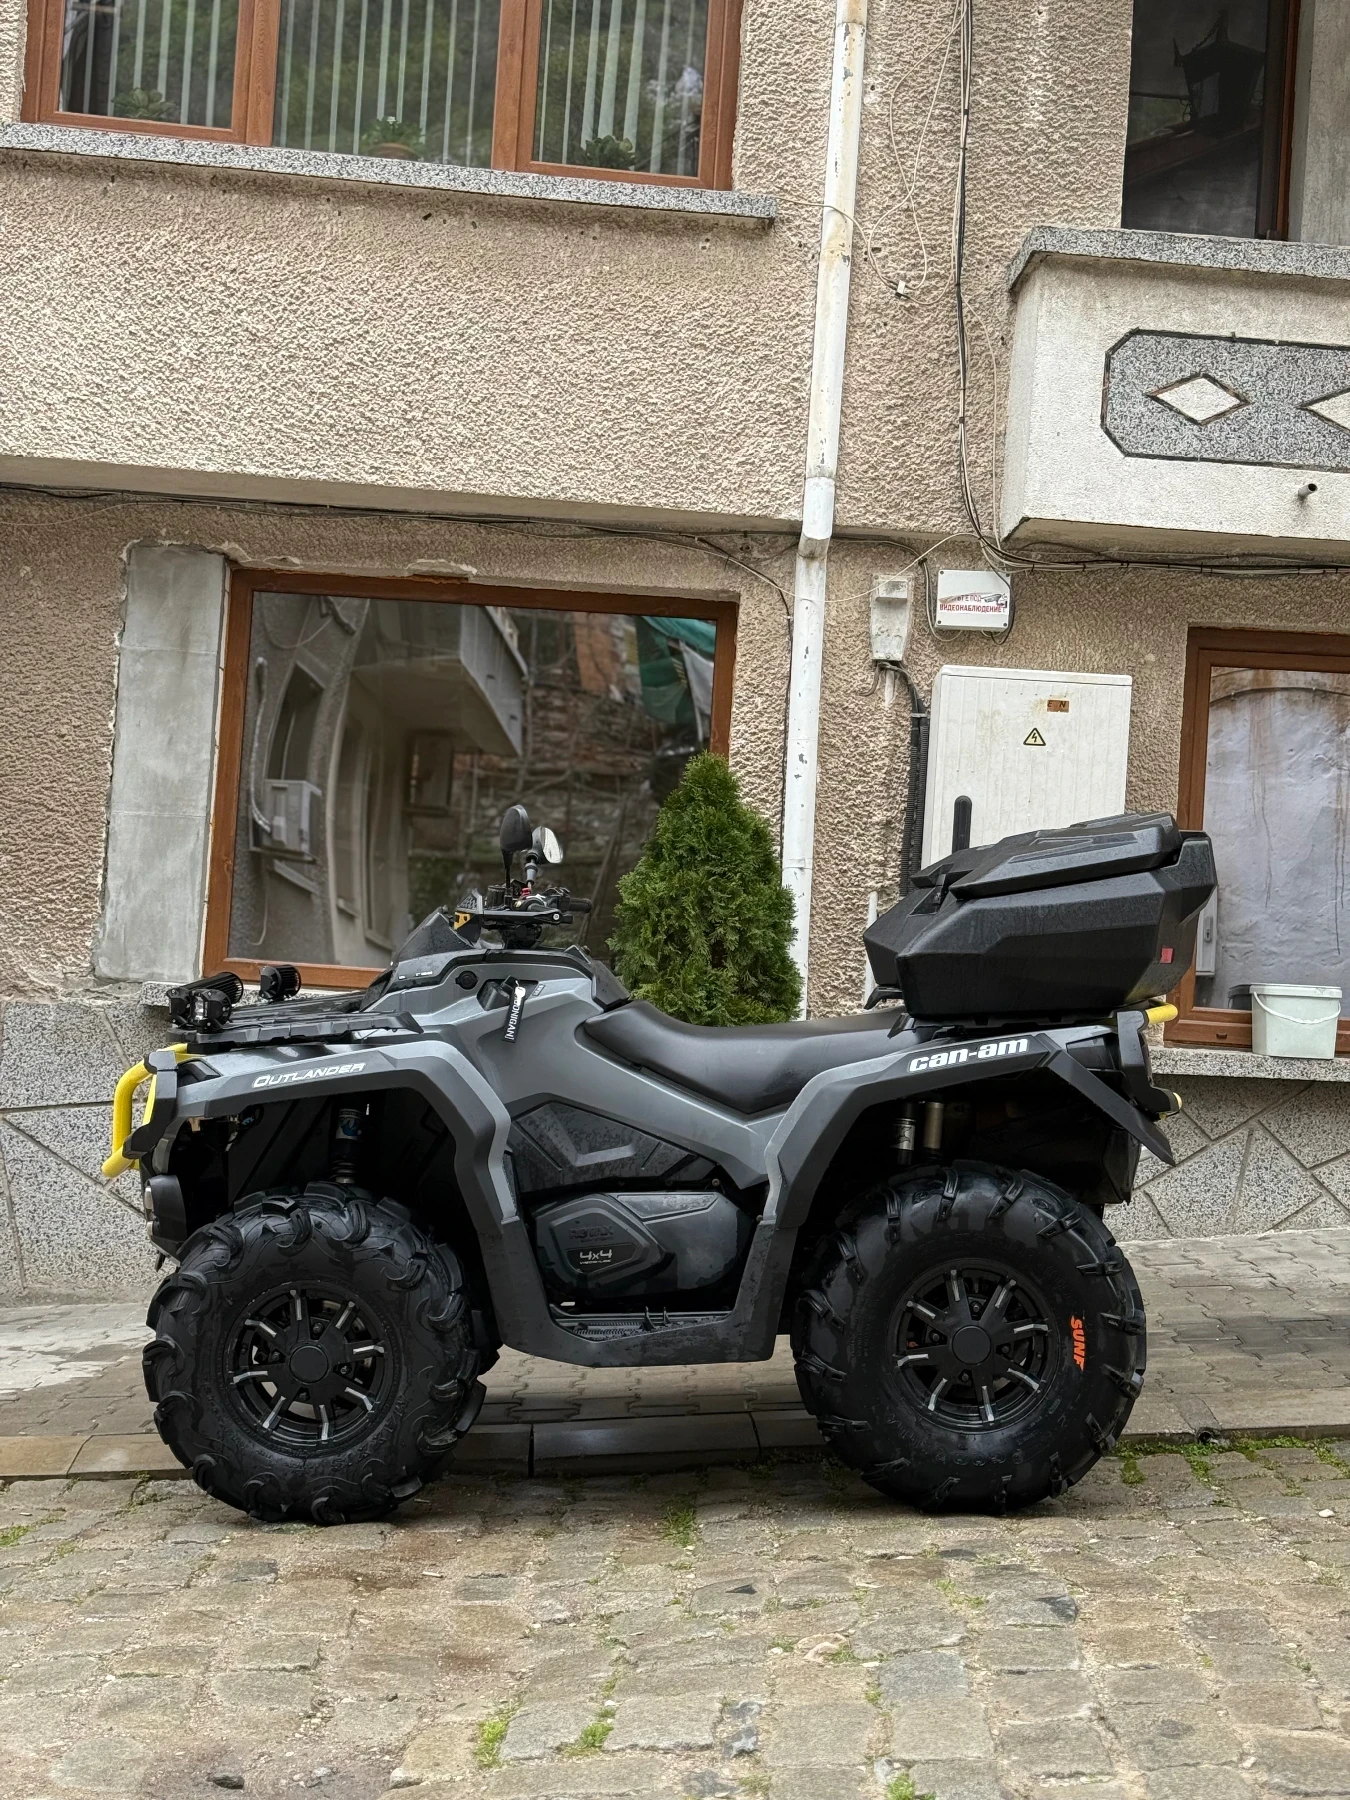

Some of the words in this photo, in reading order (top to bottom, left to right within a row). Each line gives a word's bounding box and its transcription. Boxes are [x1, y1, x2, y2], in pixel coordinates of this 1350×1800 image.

[908, 1038, 1029, 1073] can-am
[252, 1062, 367, 1089] OUTLANDER
[579, 1248, 613, 1260] 4x4
[1070, 1315, 1086, 1371] SUNF
